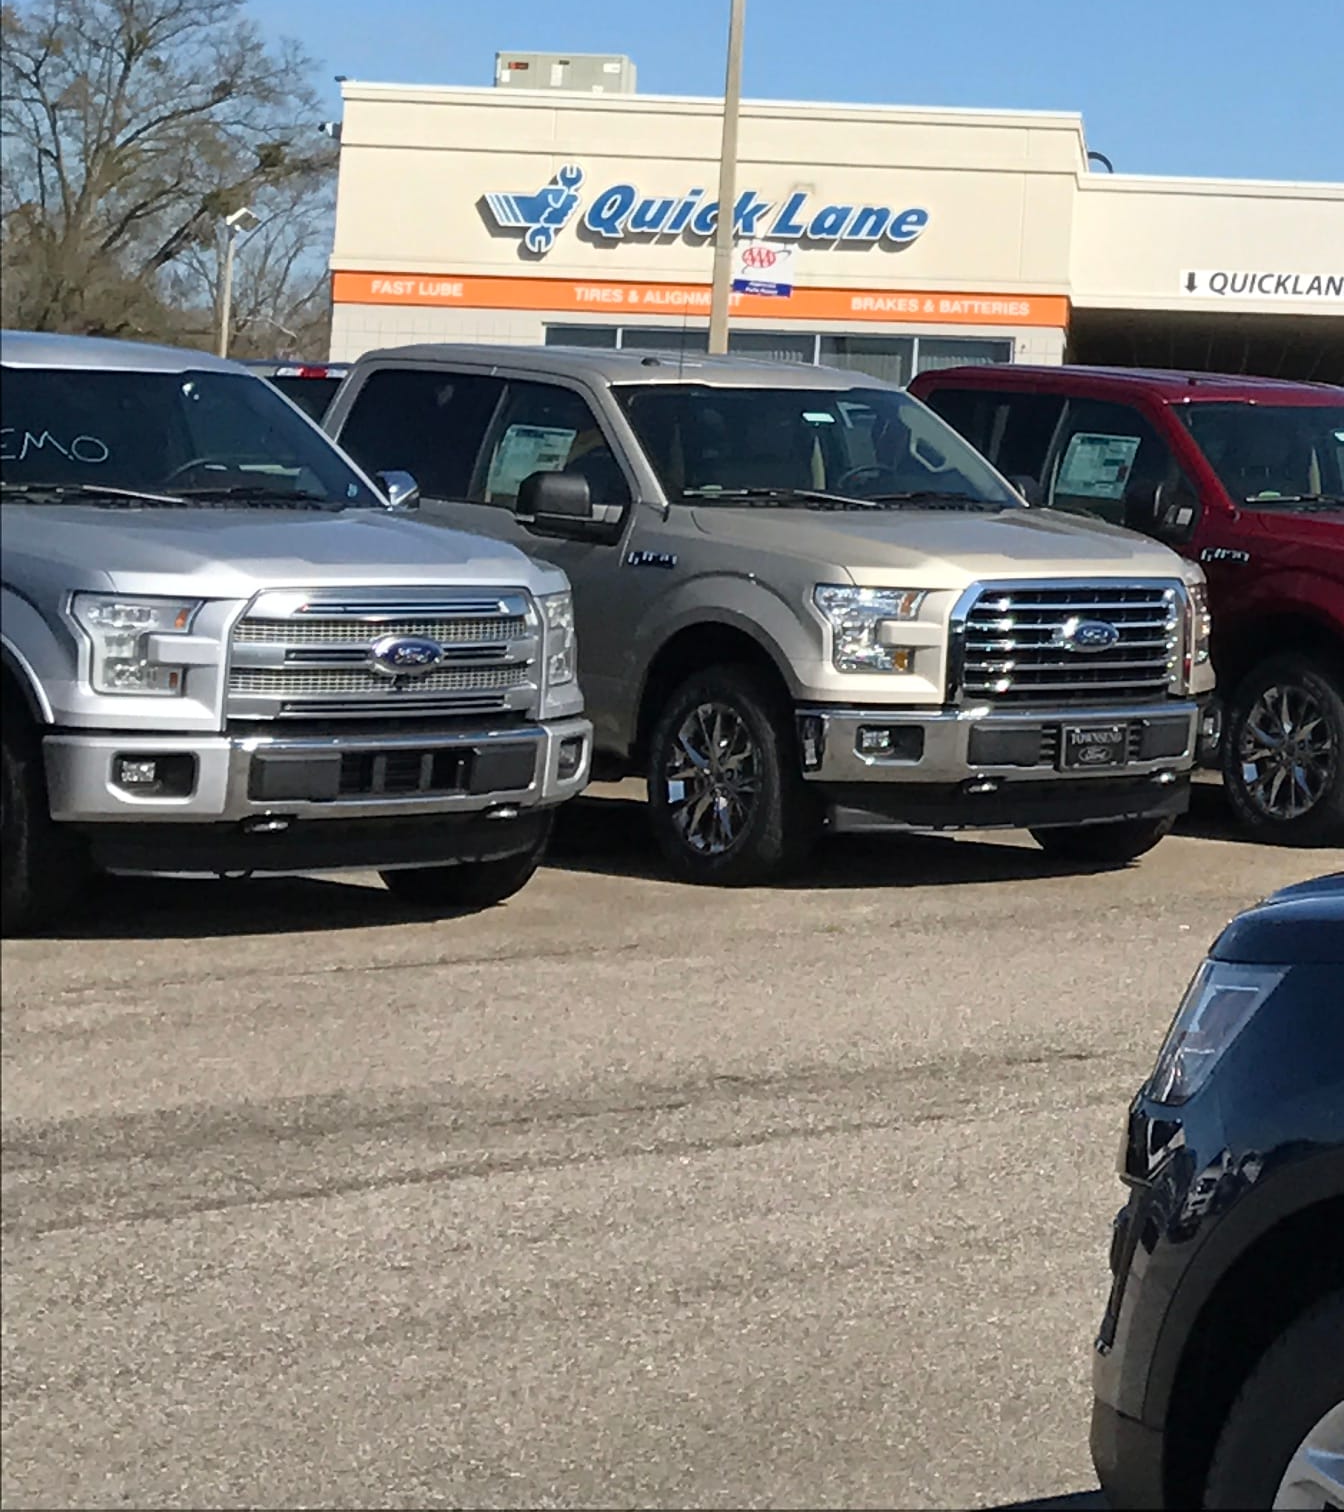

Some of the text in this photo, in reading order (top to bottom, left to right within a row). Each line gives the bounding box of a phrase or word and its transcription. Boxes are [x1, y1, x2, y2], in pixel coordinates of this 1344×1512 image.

[584, 182, 930, 242] Quick Lane
[371, 279, 464, 297] FAST LUBE
[574, 287, 743, 307] TIRES & ALIGNMT
[851, 296, 1030, 317] BRAKES & BATTERIES
